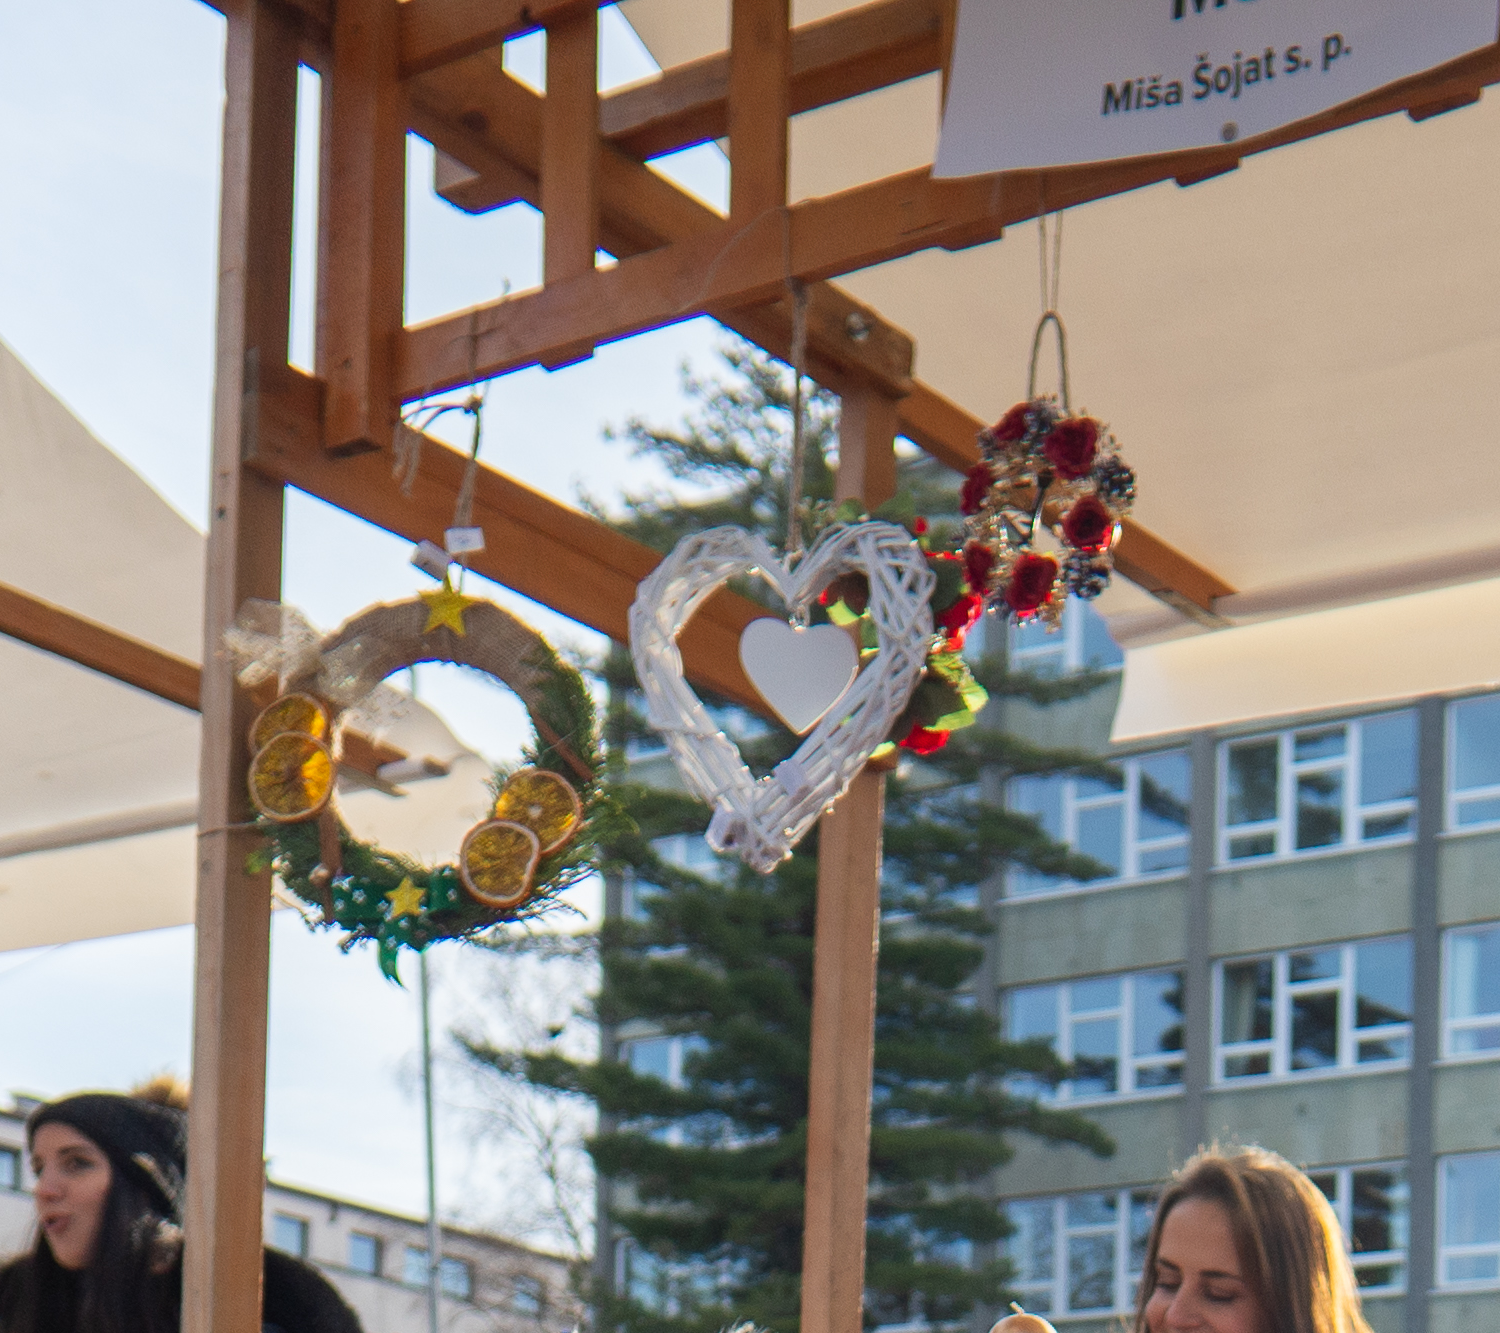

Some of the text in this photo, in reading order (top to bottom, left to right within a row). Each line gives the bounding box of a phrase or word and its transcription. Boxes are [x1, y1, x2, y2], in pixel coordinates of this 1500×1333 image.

[1100, 31, 1353, 118] Miša Šojat s. p.
